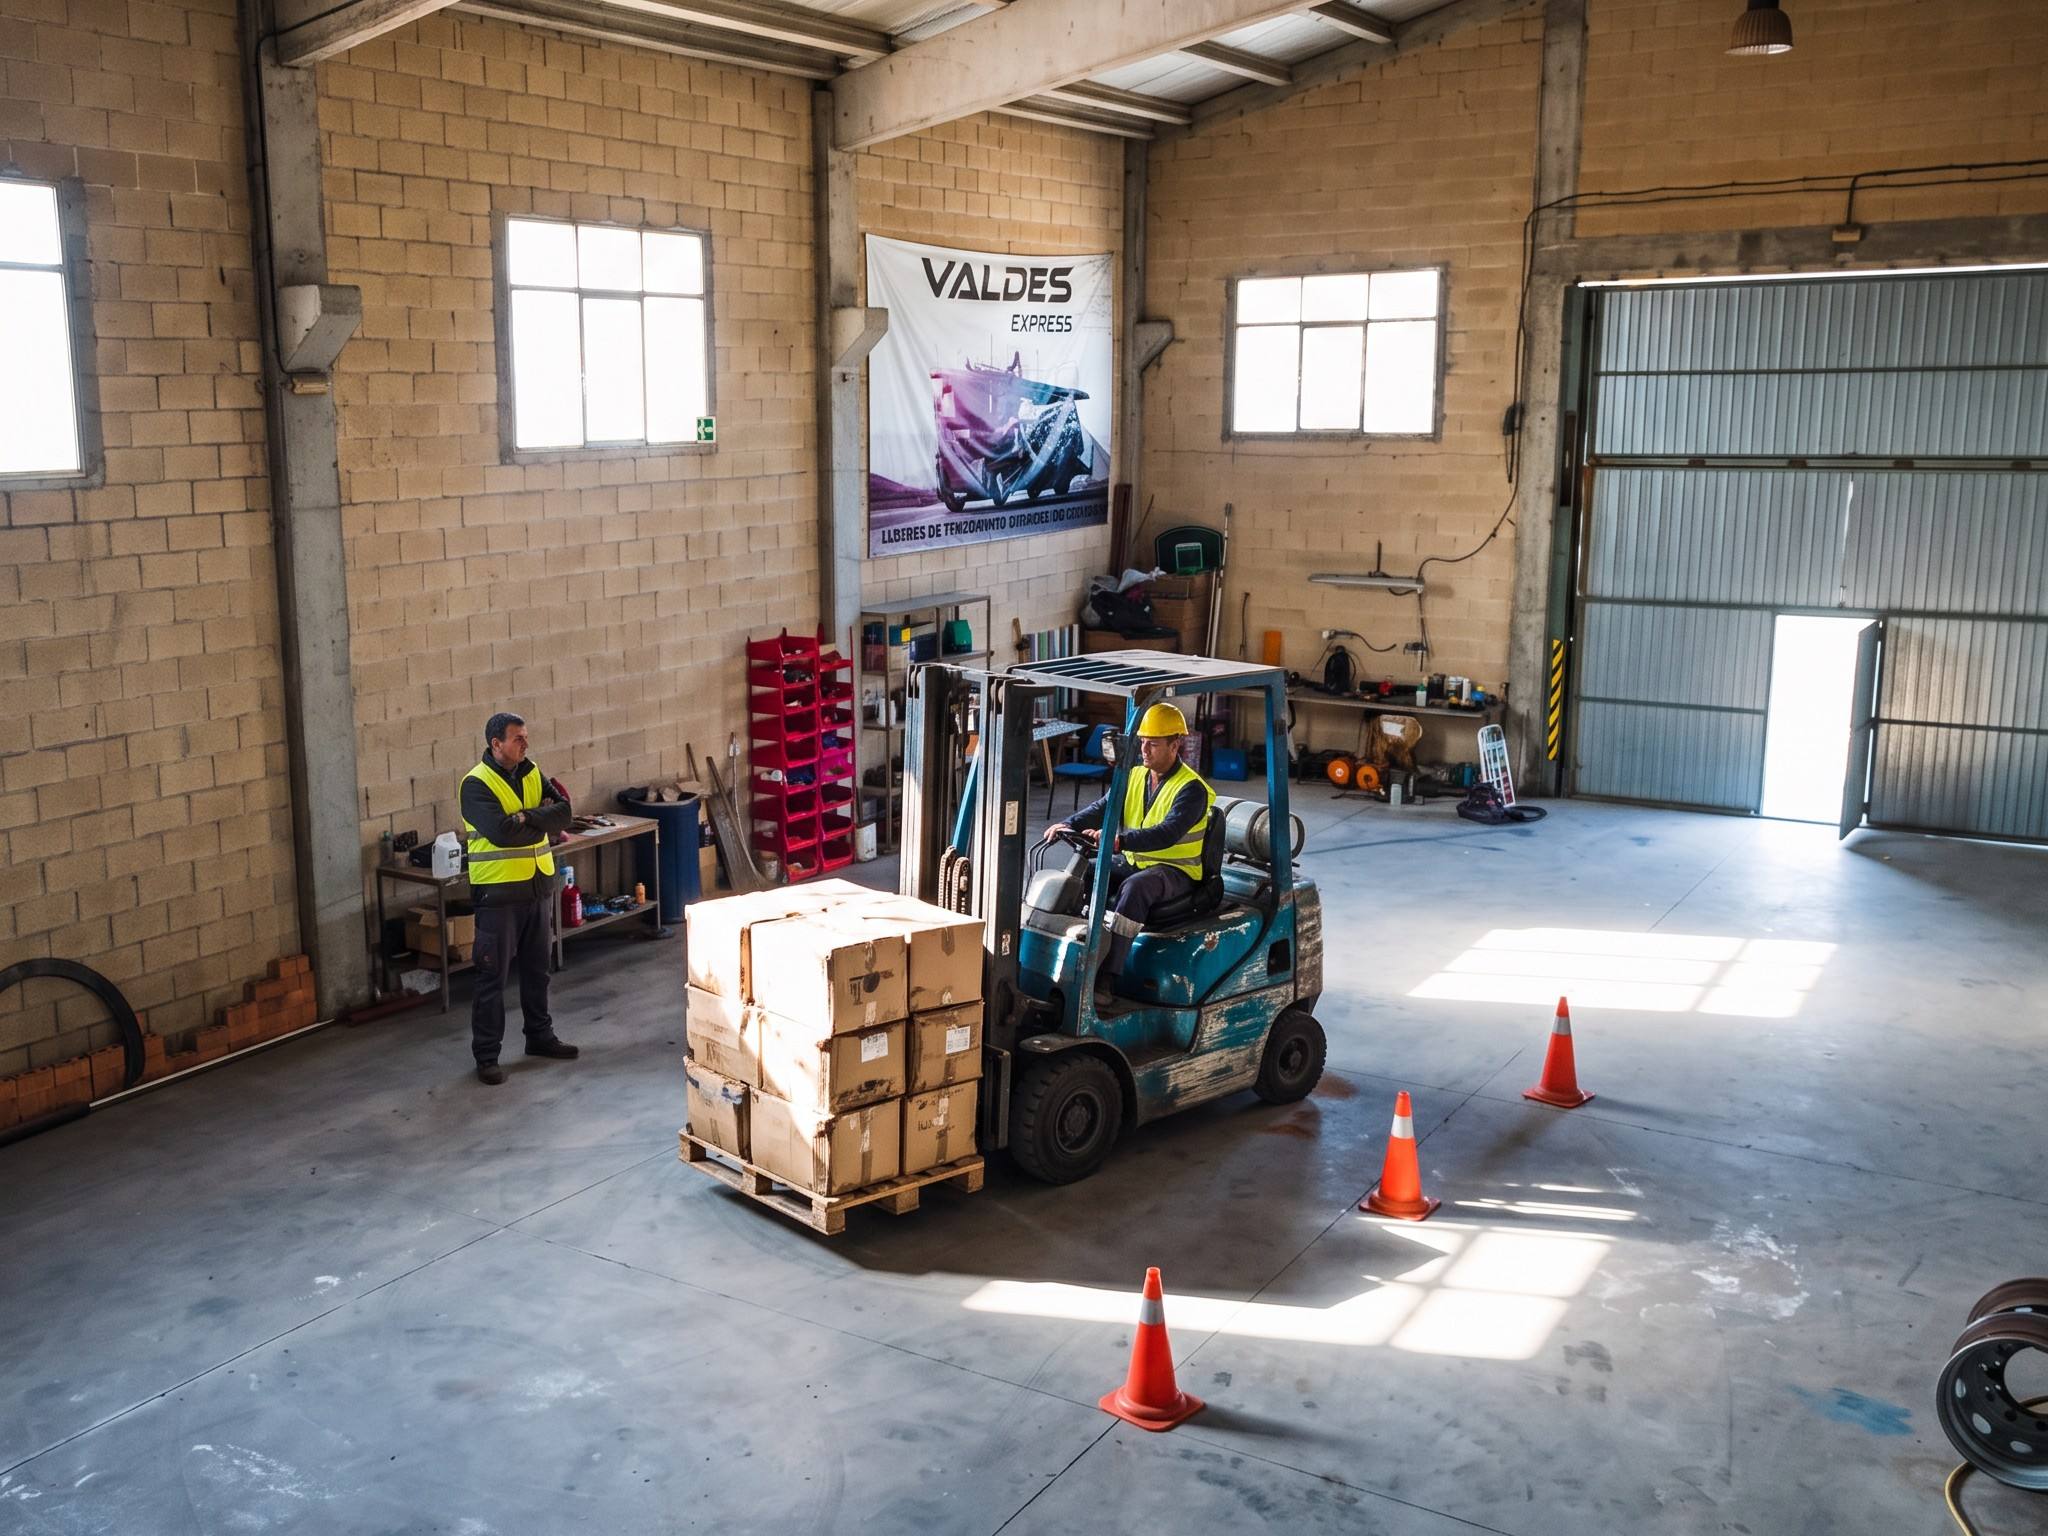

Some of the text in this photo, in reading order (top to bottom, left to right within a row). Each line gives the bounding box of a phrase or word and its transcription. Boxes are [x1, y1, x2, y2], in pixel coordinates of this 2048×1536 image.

[921, 257, 1074, 303] VALDES
[1011, 314, 1073, 332] EXPRESS
[928, 523, 942, 539] DE
